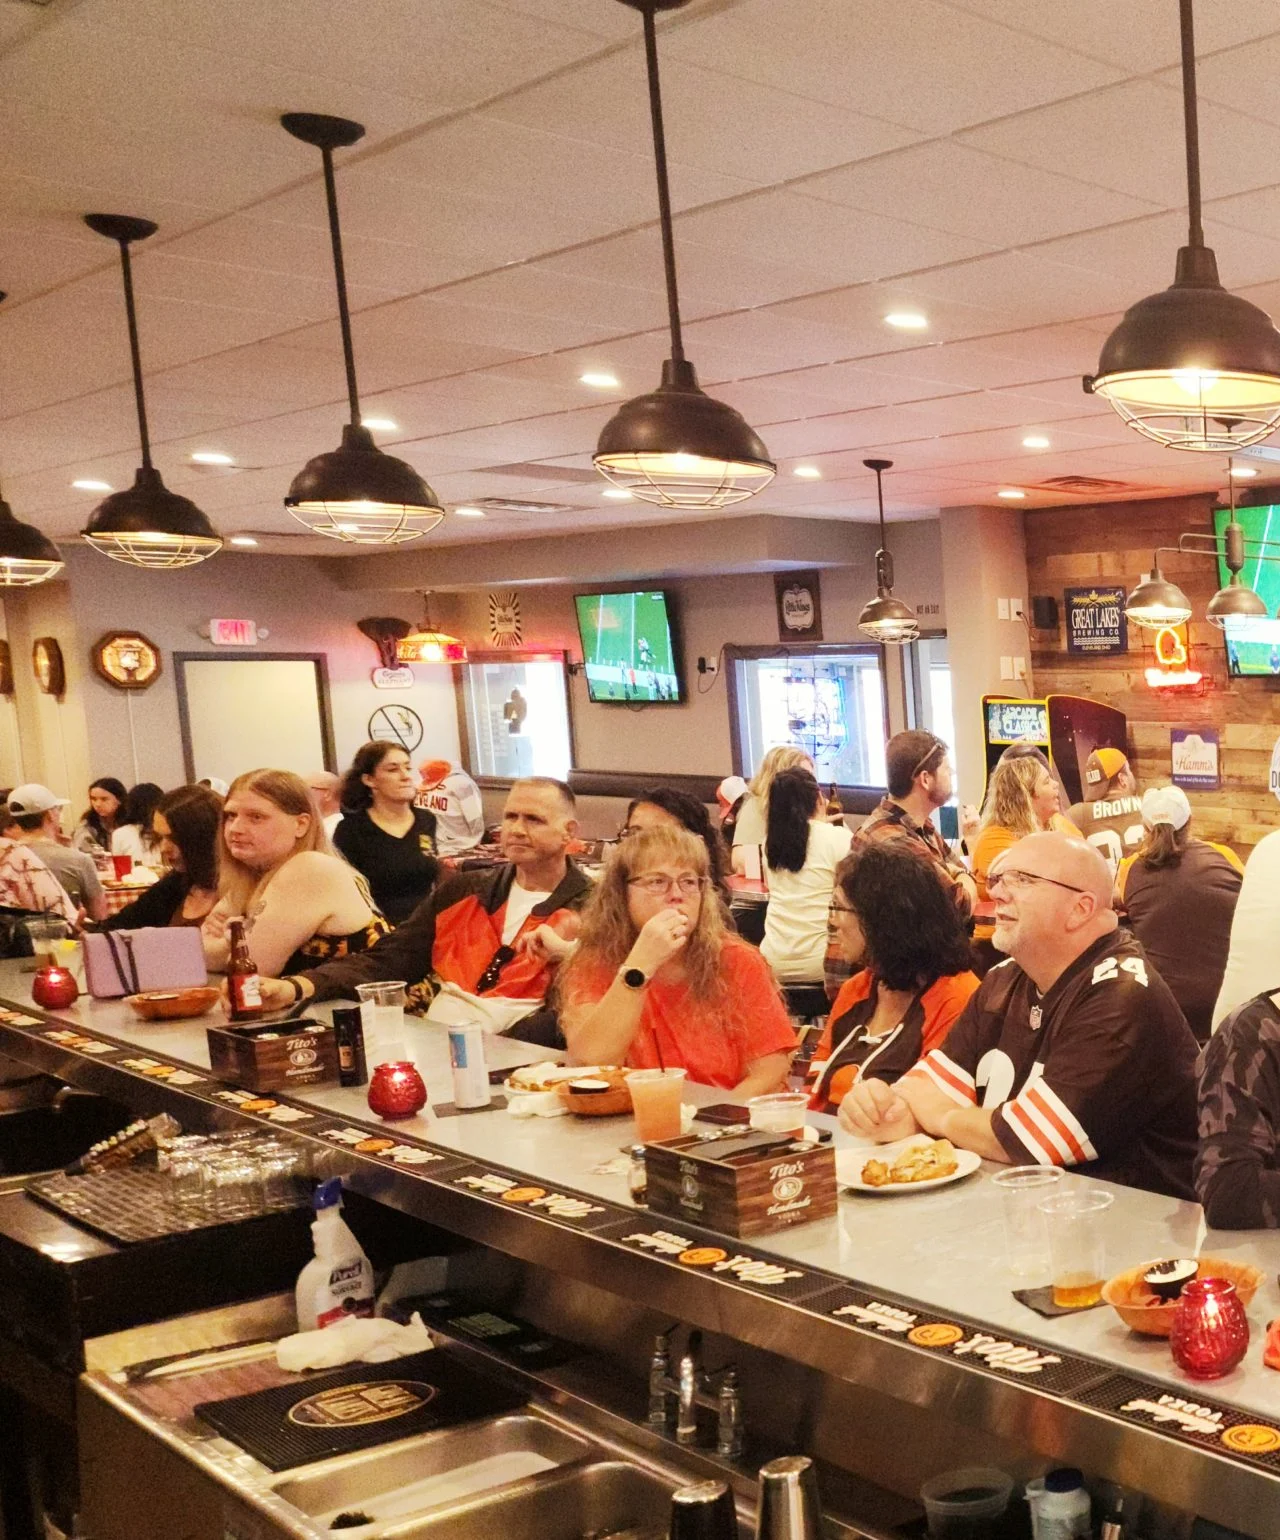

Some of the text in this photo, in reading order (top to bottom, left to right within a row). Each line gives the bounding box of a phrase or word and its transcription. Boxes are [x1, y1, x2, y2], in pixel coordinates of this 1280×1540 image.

[1072, 607, 1119, 629] GREAT LAKES
[1073, 629, 1104, 637] BREWING
[1093, 796, 1142, 819] BROWN
[1092, 957, 1148, 987] 24
[769, 1161, 805, 1180] Tito's
[1157, 1394, 1223, 1423] VODKA
